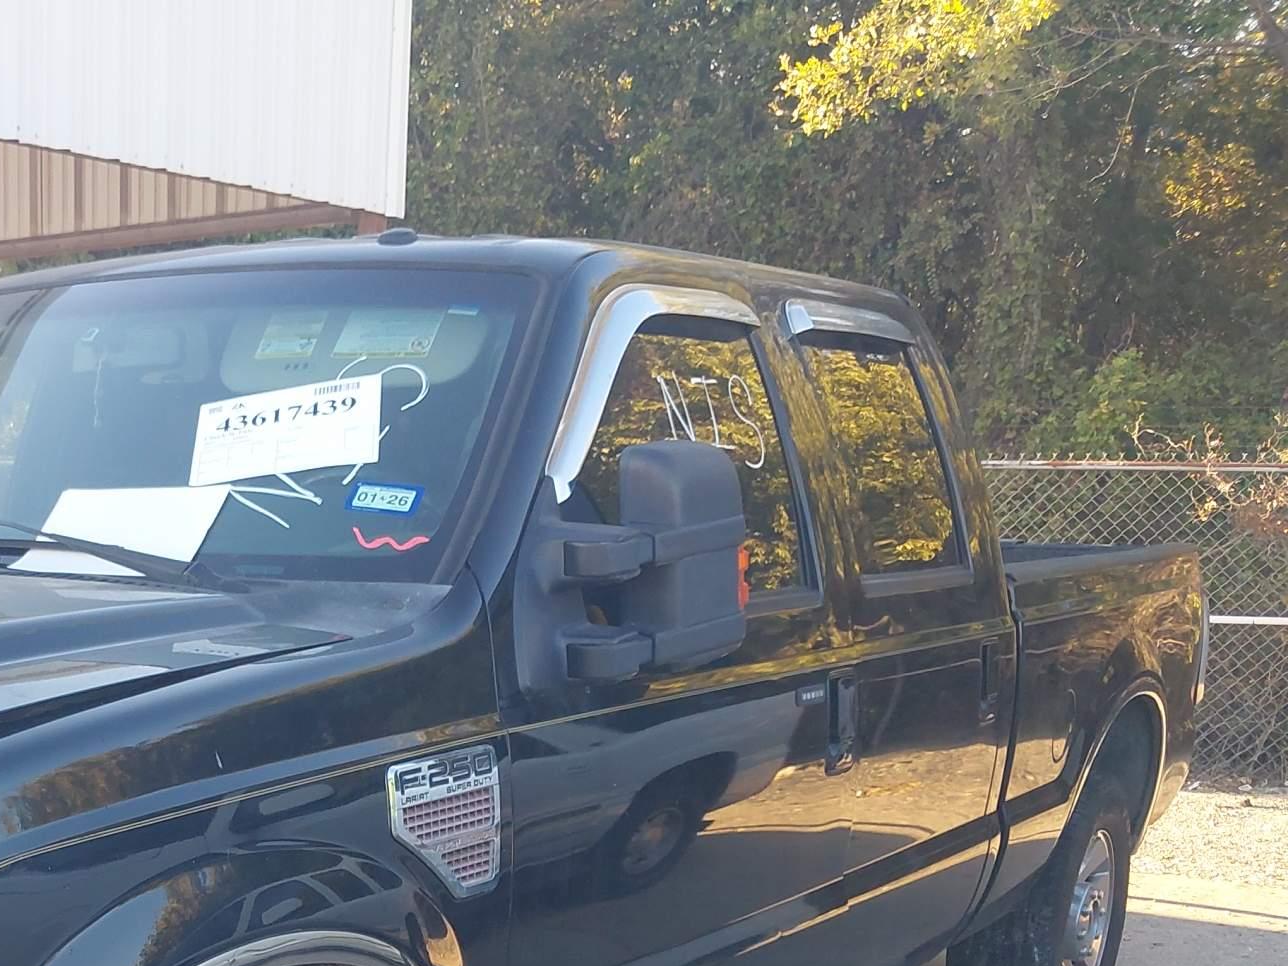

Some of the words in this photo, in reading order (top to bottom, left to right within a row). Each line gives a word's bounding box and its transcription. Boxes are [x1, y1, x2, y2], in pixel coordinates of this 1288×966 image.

[216, 397, 357, 433] 43617439
[357, 491, 378, 503] 01
[386, 494, 410, 507] 26
[401, 792, 430, 806] LARIAT
[446, 782, 472, 795] SUPER
[473, 776, 493, 787] DUTY
